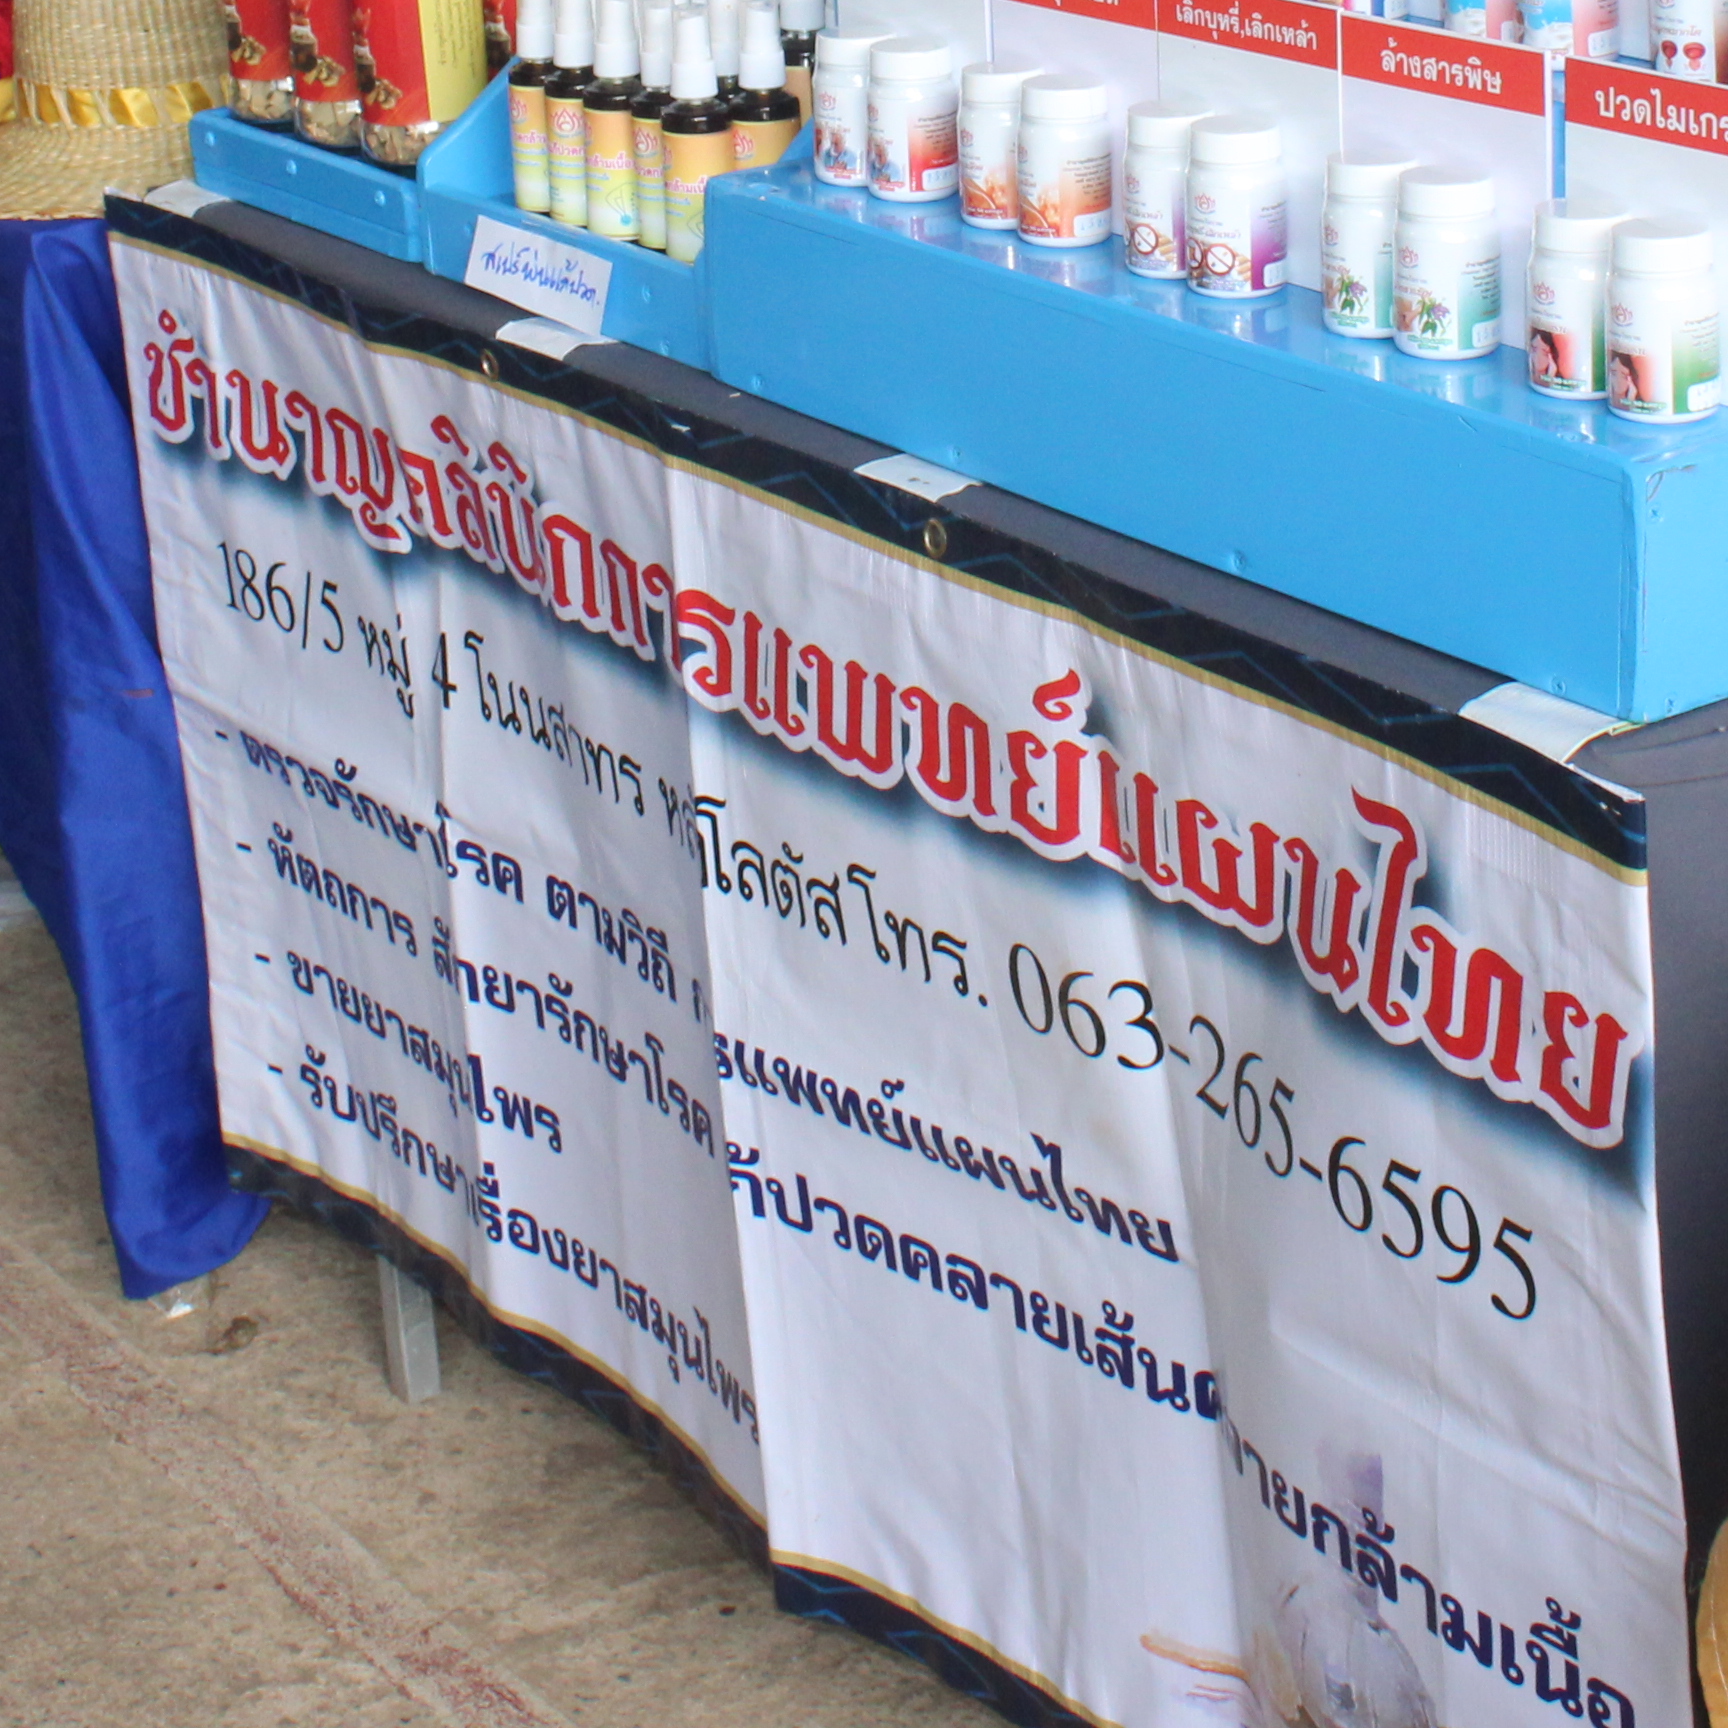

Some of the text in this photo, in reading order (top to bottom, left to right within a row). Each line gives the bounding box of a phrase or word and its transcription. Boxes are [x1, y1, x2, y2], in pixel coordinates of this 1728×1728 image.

[1175, 0, 1318, 51] เลิกบุหรี่,เลิกเหล้า
[1380, 37, 1503, 95] ล้างสารพิษ
[216, 540, 346, 655] 186/5
[357, 613, 415, 718] หมู่
[431, 631, 458, 710] 4
[1009, 942, 1536, 1320] 063-265-6595
[268, 824, 418, 957] หัตถการ
[241, 730, 525, 903] ตรวจรักษาโรค
[547, 874, 677, 1003] ตามวิถี
[692, 978, 1180, 1263] กรแพทย์แผนไทย
[286, 950, 564, 1154] ขายยาสมุนไพร
